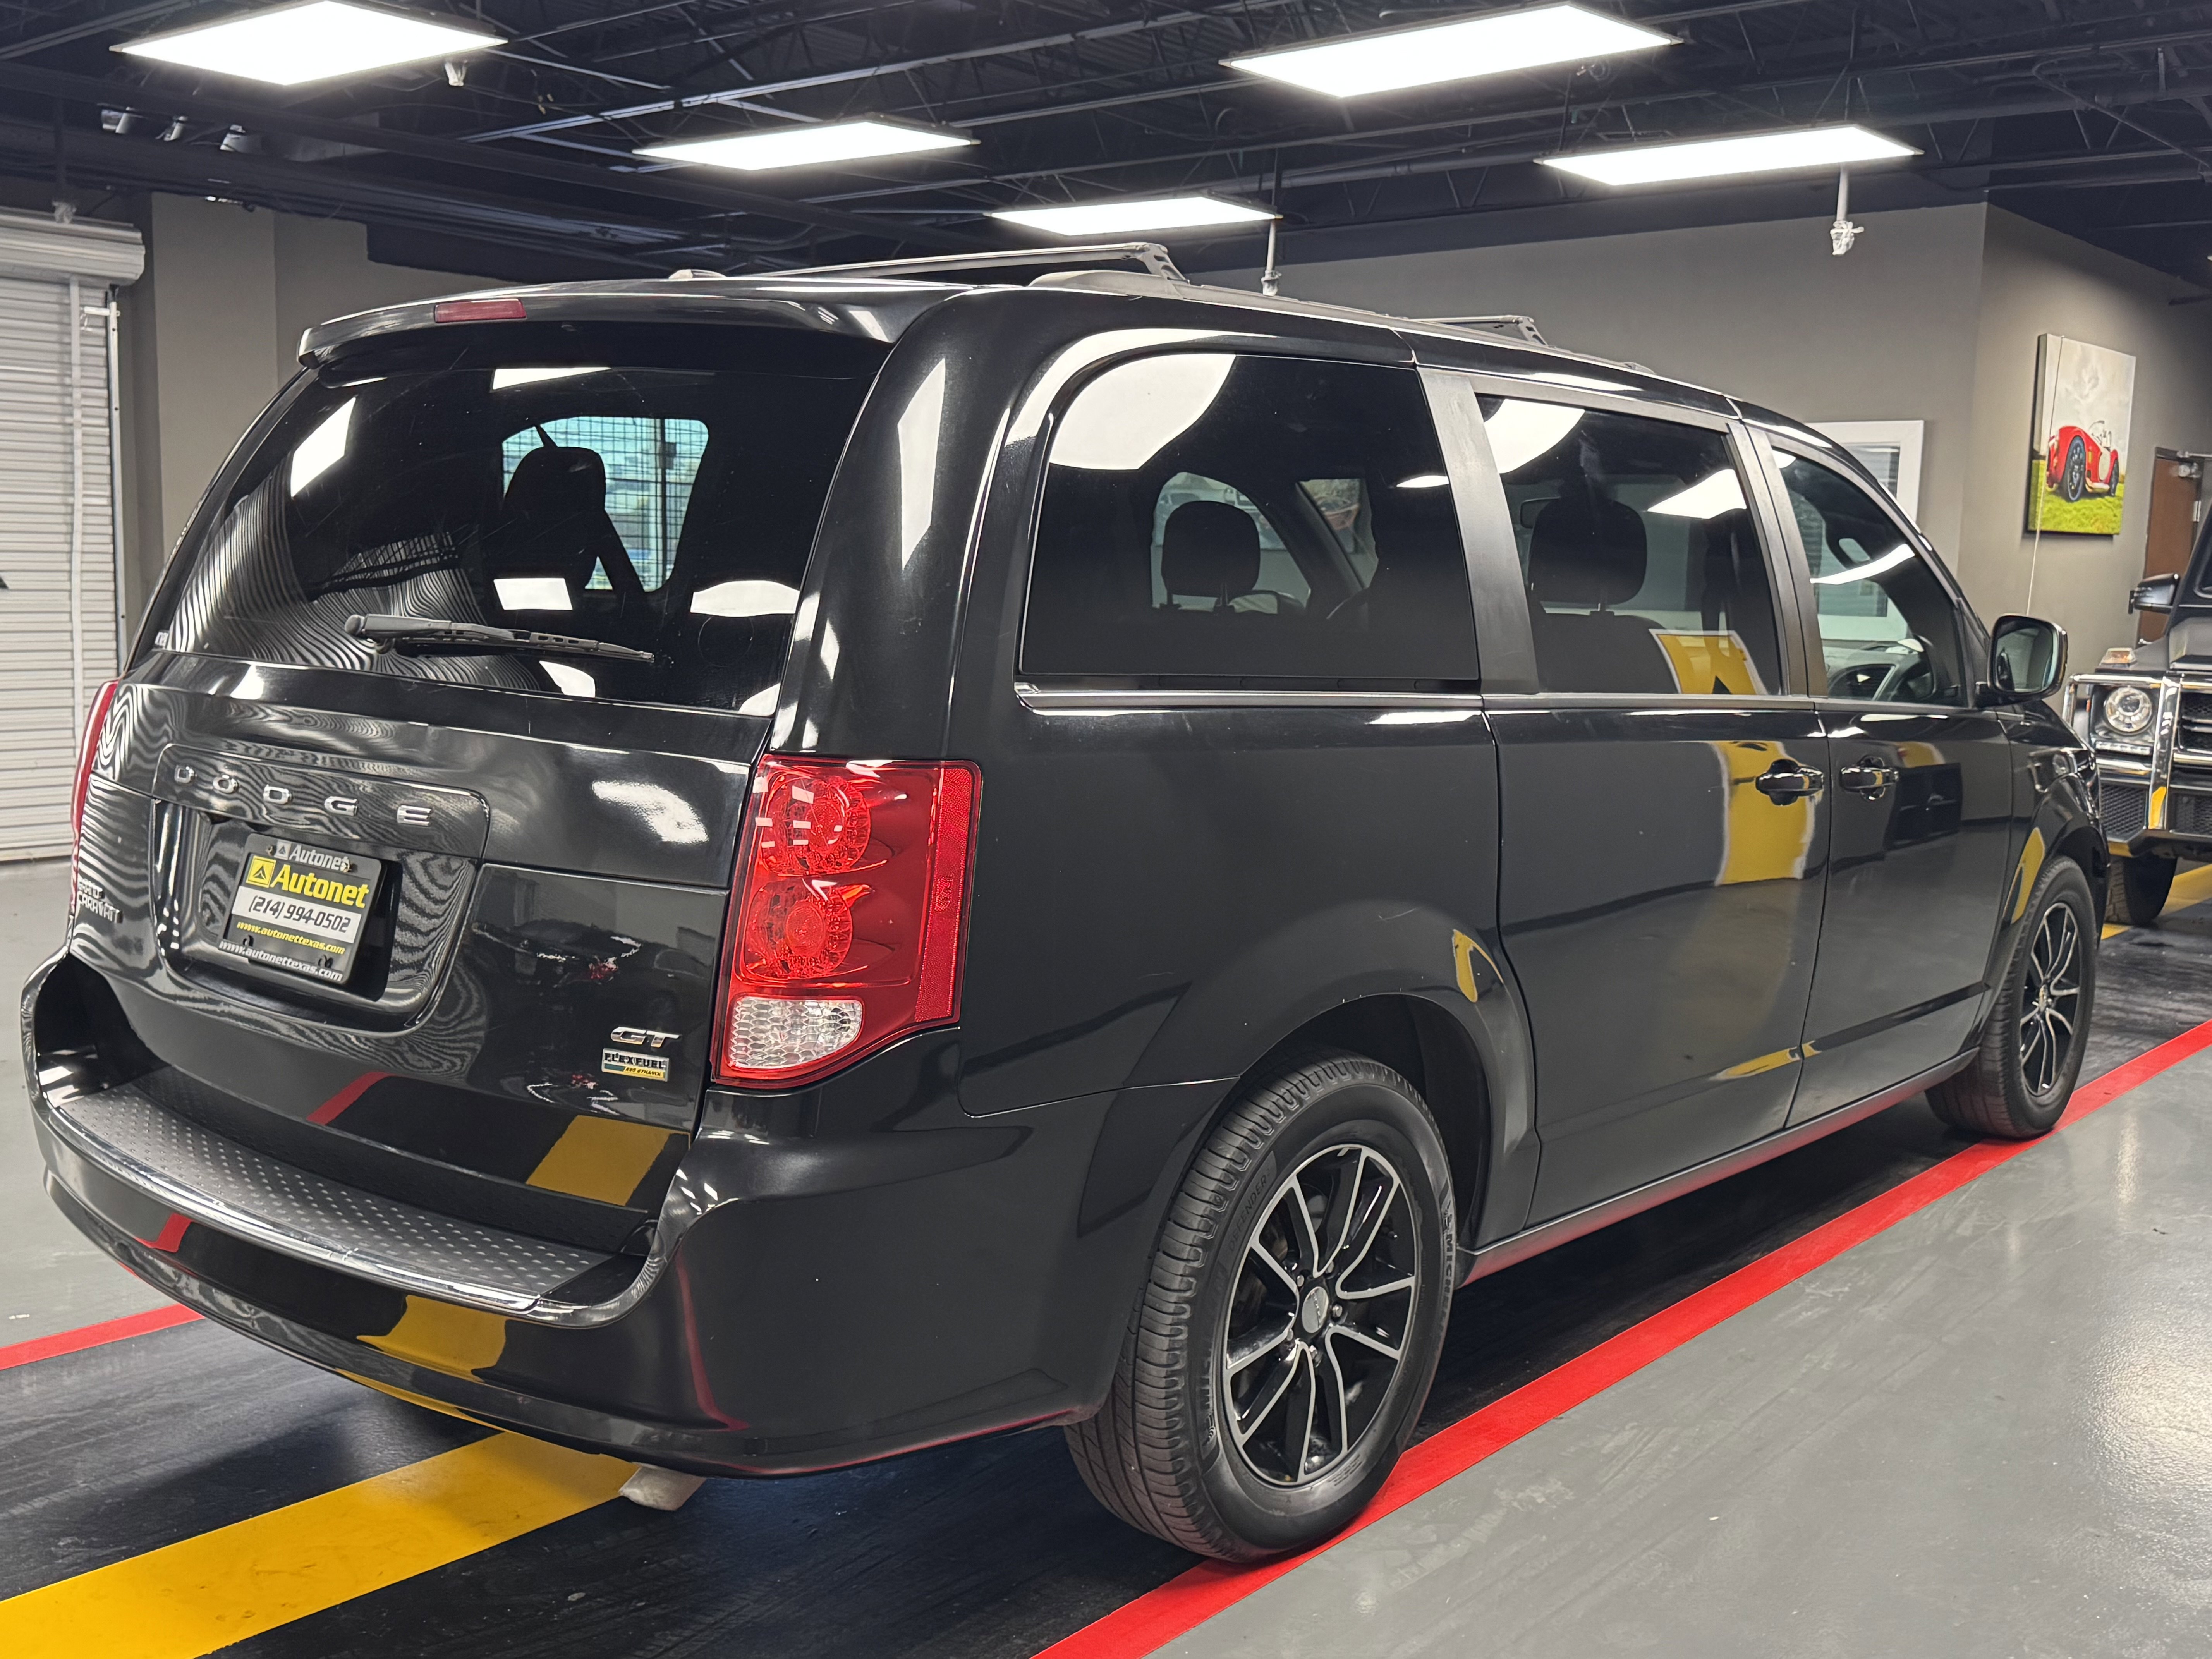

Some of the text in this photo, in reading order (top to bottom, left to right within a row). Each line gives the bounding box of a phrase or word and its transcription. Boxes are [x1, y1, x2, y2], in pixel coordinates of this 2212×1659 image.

[174, 764, 433, 826] DODGE
[270, 864, 369, 908] Autonet
[249, 895, 351, 933] (214) 994-0502
[237, 921, 345, 955] www.autonettexas.com
[219, 940, 343, 982] www.autonettexas.com
[610, 1026, 681, 1048] GT
